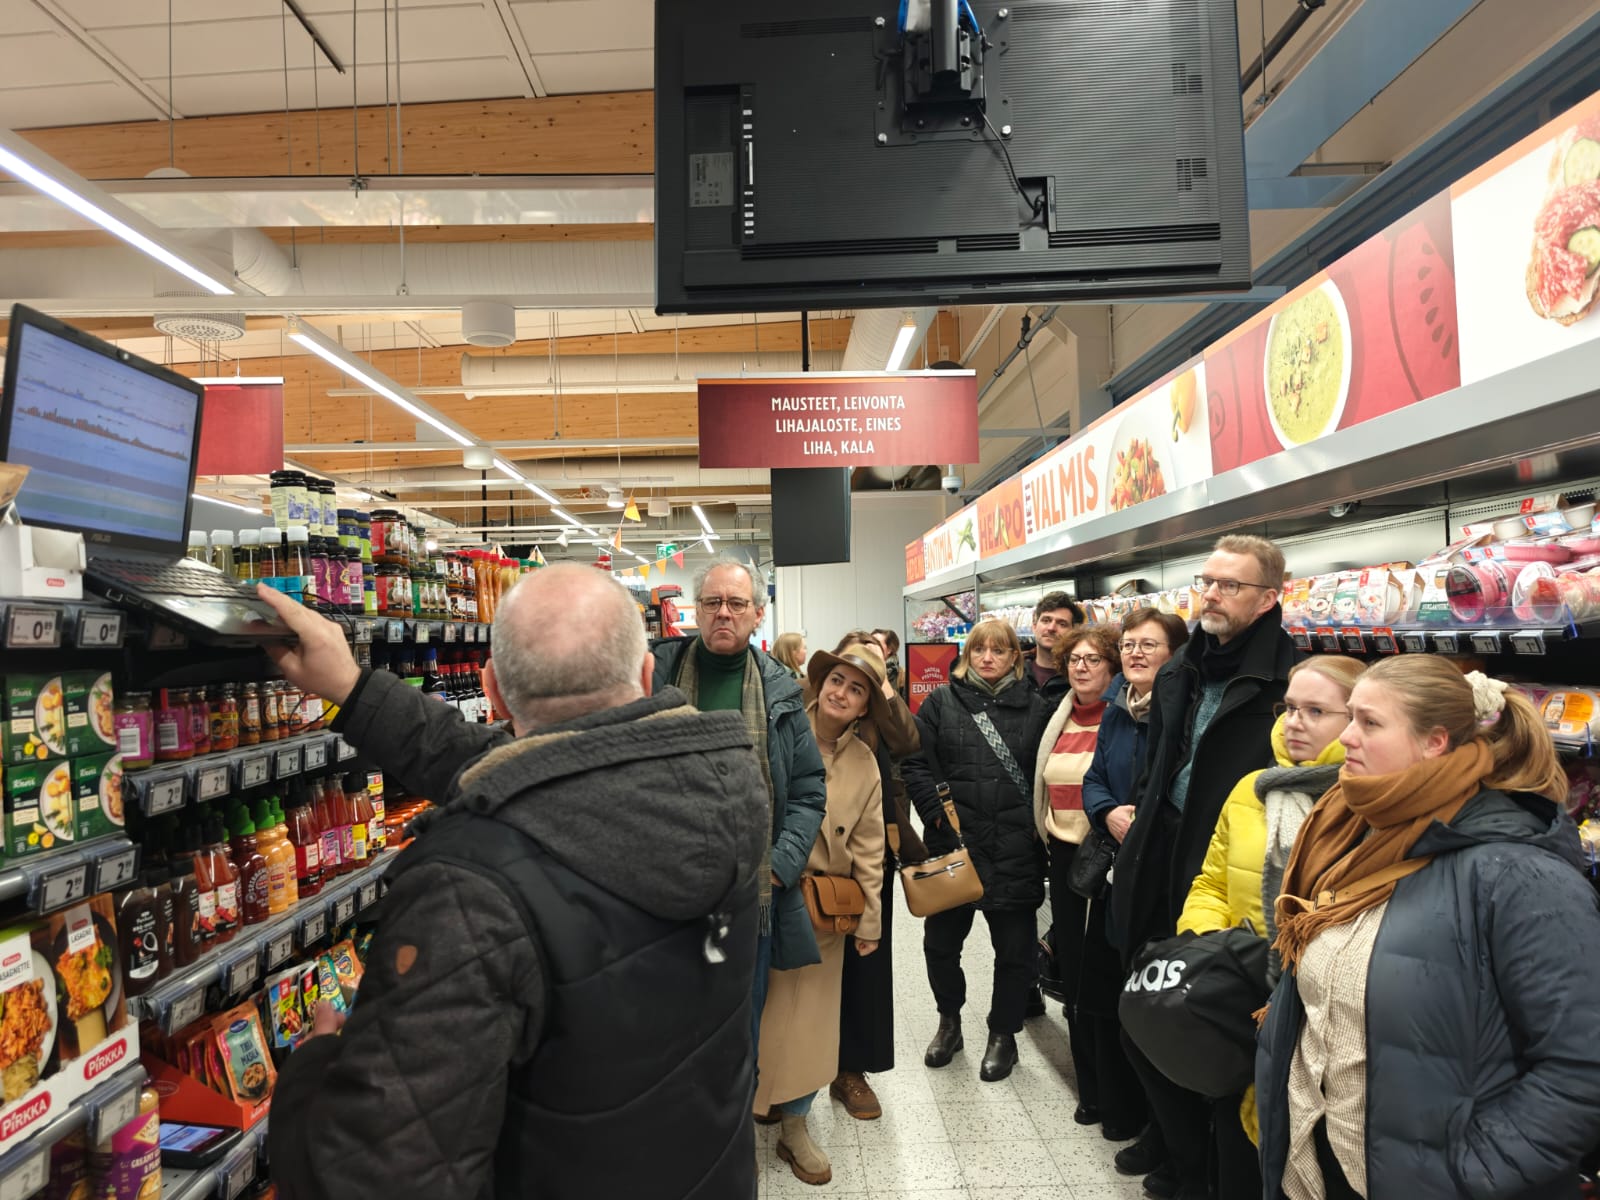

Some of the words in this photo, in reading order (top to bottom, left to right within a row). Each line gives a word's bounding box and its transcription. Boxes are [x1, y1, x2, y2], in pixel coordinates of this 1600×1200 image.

[772, 396, 841, 414] MAUSTEET,
[844, 395, 905, 411] LEIVONTA
[776, 418, 863, 434] LIHAJALOSTE,
[866, 417, 901, 431] EINES
[803, 440, 838, 457] LIHA,
[841, 440, 875, 455] KALA
[1031, 444, 1099, 532] VALMIS
[65, 879, 74, 899] 2
[0, 960, 31, 981] ASAGNETTE
